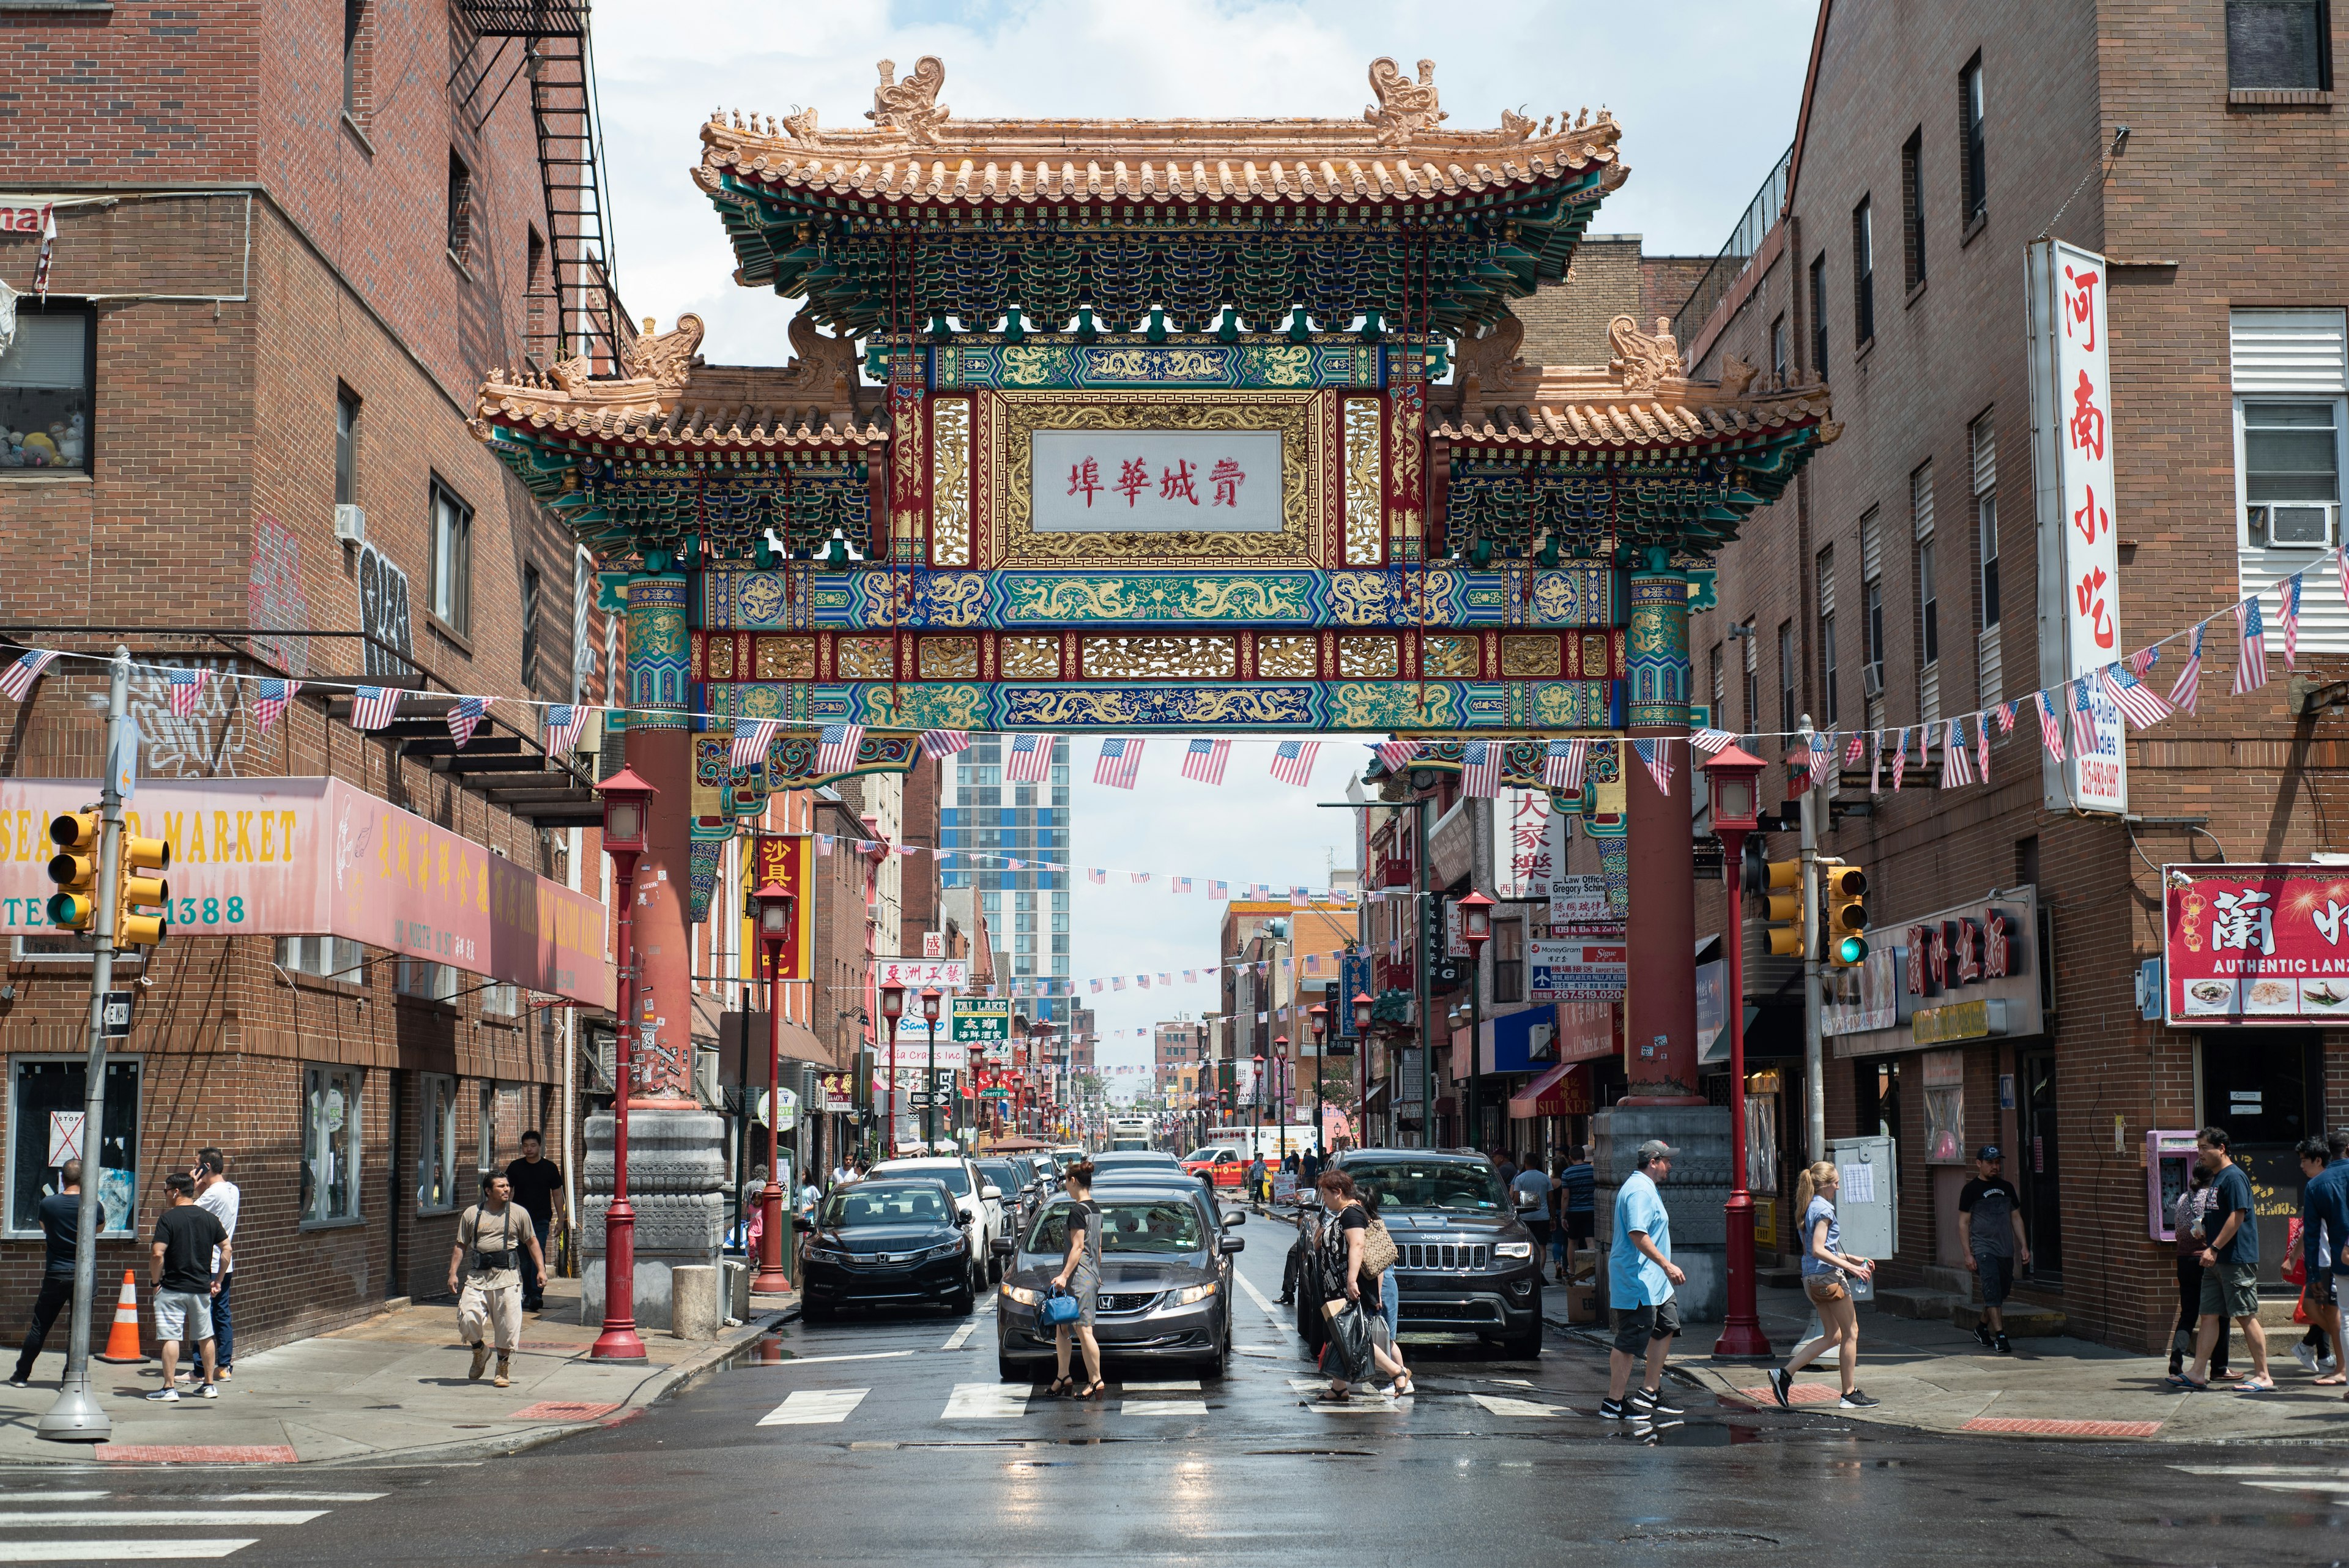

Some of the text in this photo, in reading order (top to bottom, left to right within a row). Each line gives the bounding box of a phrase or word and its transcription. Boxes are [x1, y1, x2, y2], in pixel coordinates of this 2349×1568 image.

[2065, 264, 2113, 649] 河南小吃
[2082, 759, 2119, 798] 215-982-1997
[0, 809, 296, 863] SEAD MARKET
[1508, 793, 1553, 880] 大家樂
[1553, 885, 1581, 894] Gregory
[520, 879, 601, 959] GREAT WALL SEAFOOD MARKET
[408, 921, 431, 950] NORTH
[444, 932, 451, 956] ST
[926, 935, 940, 956] 盛
[1597, 948, 1616, 958] Sigue
[2213, 959, 2306, 973] AUTHENTIC
[116, 1006, 128, 1022] WAY
[956, 1001, 1006, 1011] TAI LAKE
[900, 1019, 944, 1031] Sanro
[959, 1031, 1002, 1039] 海鮮酒家
[882, 1049, 963, 1060] Aia Crats Inc.
[2003, 1079, 2012, 1099] ATM
[1538, 1101, 1590, 1114] SIU KEE
